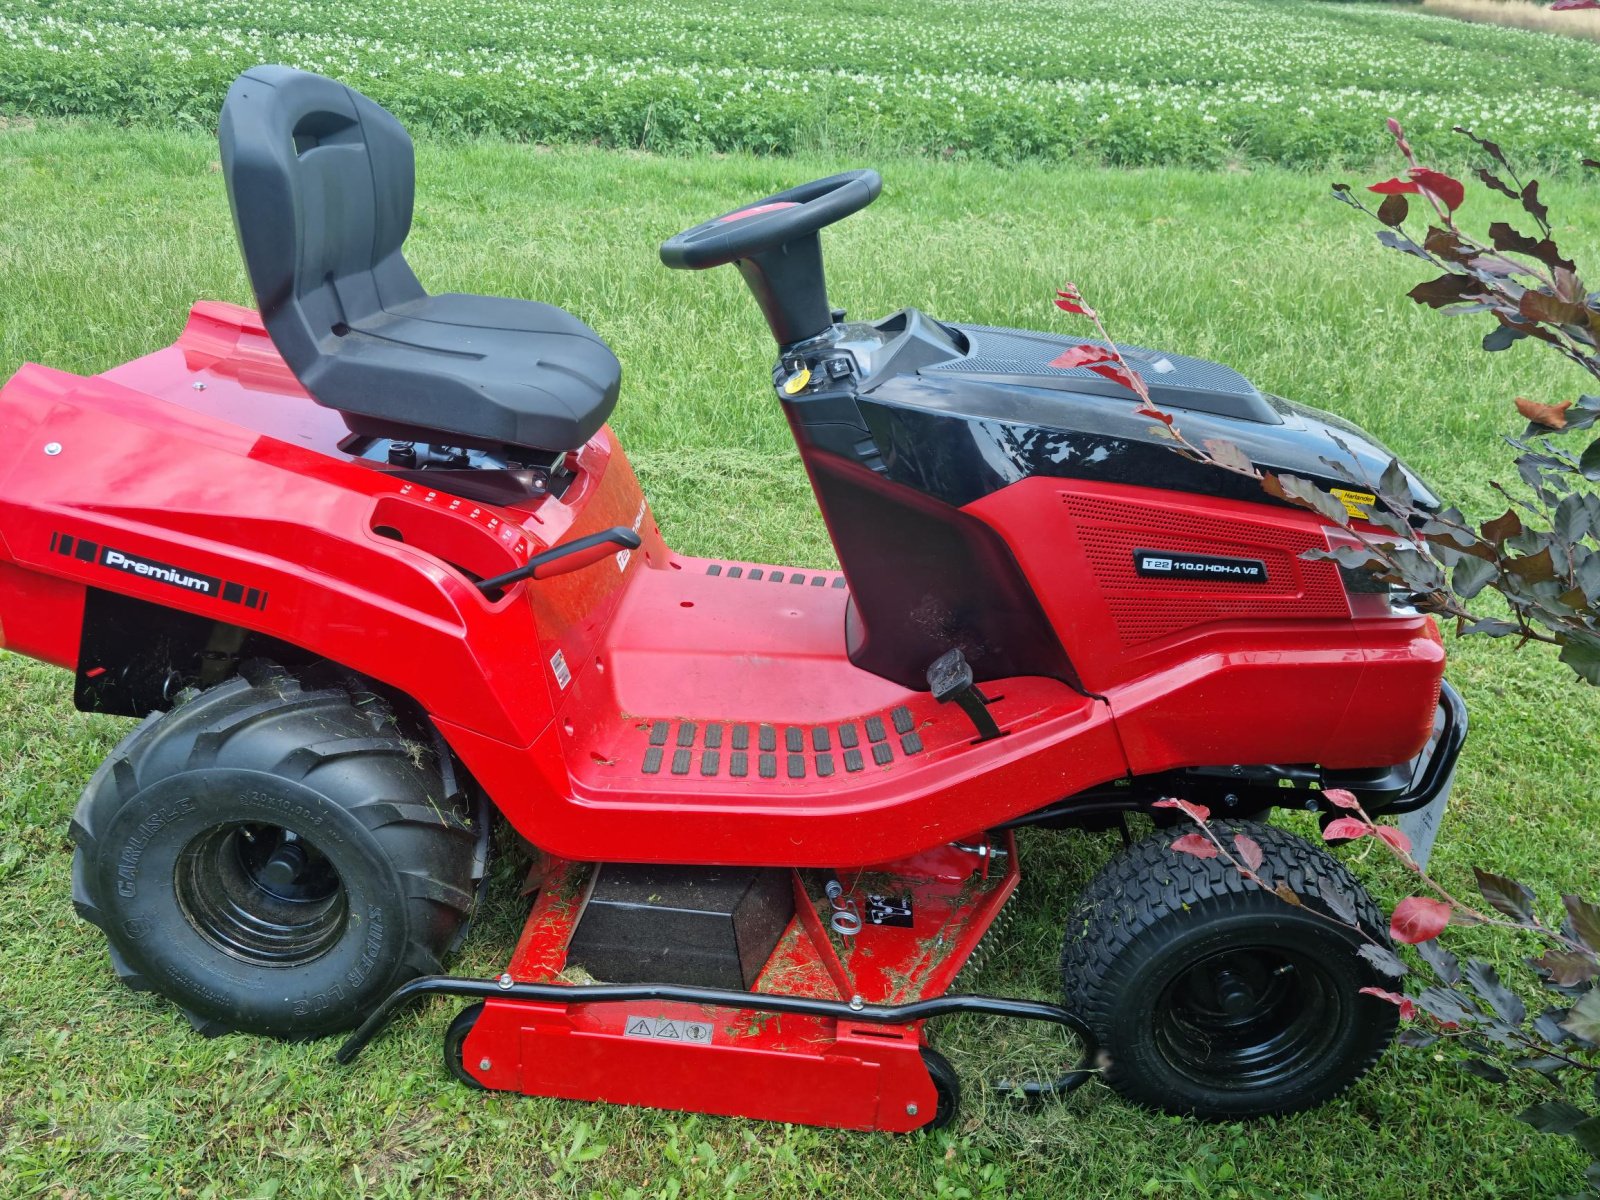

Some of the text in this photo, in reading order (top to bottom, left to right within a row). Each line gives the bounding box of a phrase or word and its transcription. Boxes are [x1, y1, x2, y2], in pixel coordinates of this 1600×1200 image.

[1344, 492, 1374, 502] Harlander
[105, 550, 210, 592] Premium
[1173, 562, 1204, 571] 110.0
[1205, 563, 1241, 574] HDH-A
[1243, 566, 1259, 575] V2
[117, 797, 197, 898] CARLISLE
[347, 903, 385, 988] SUPER
